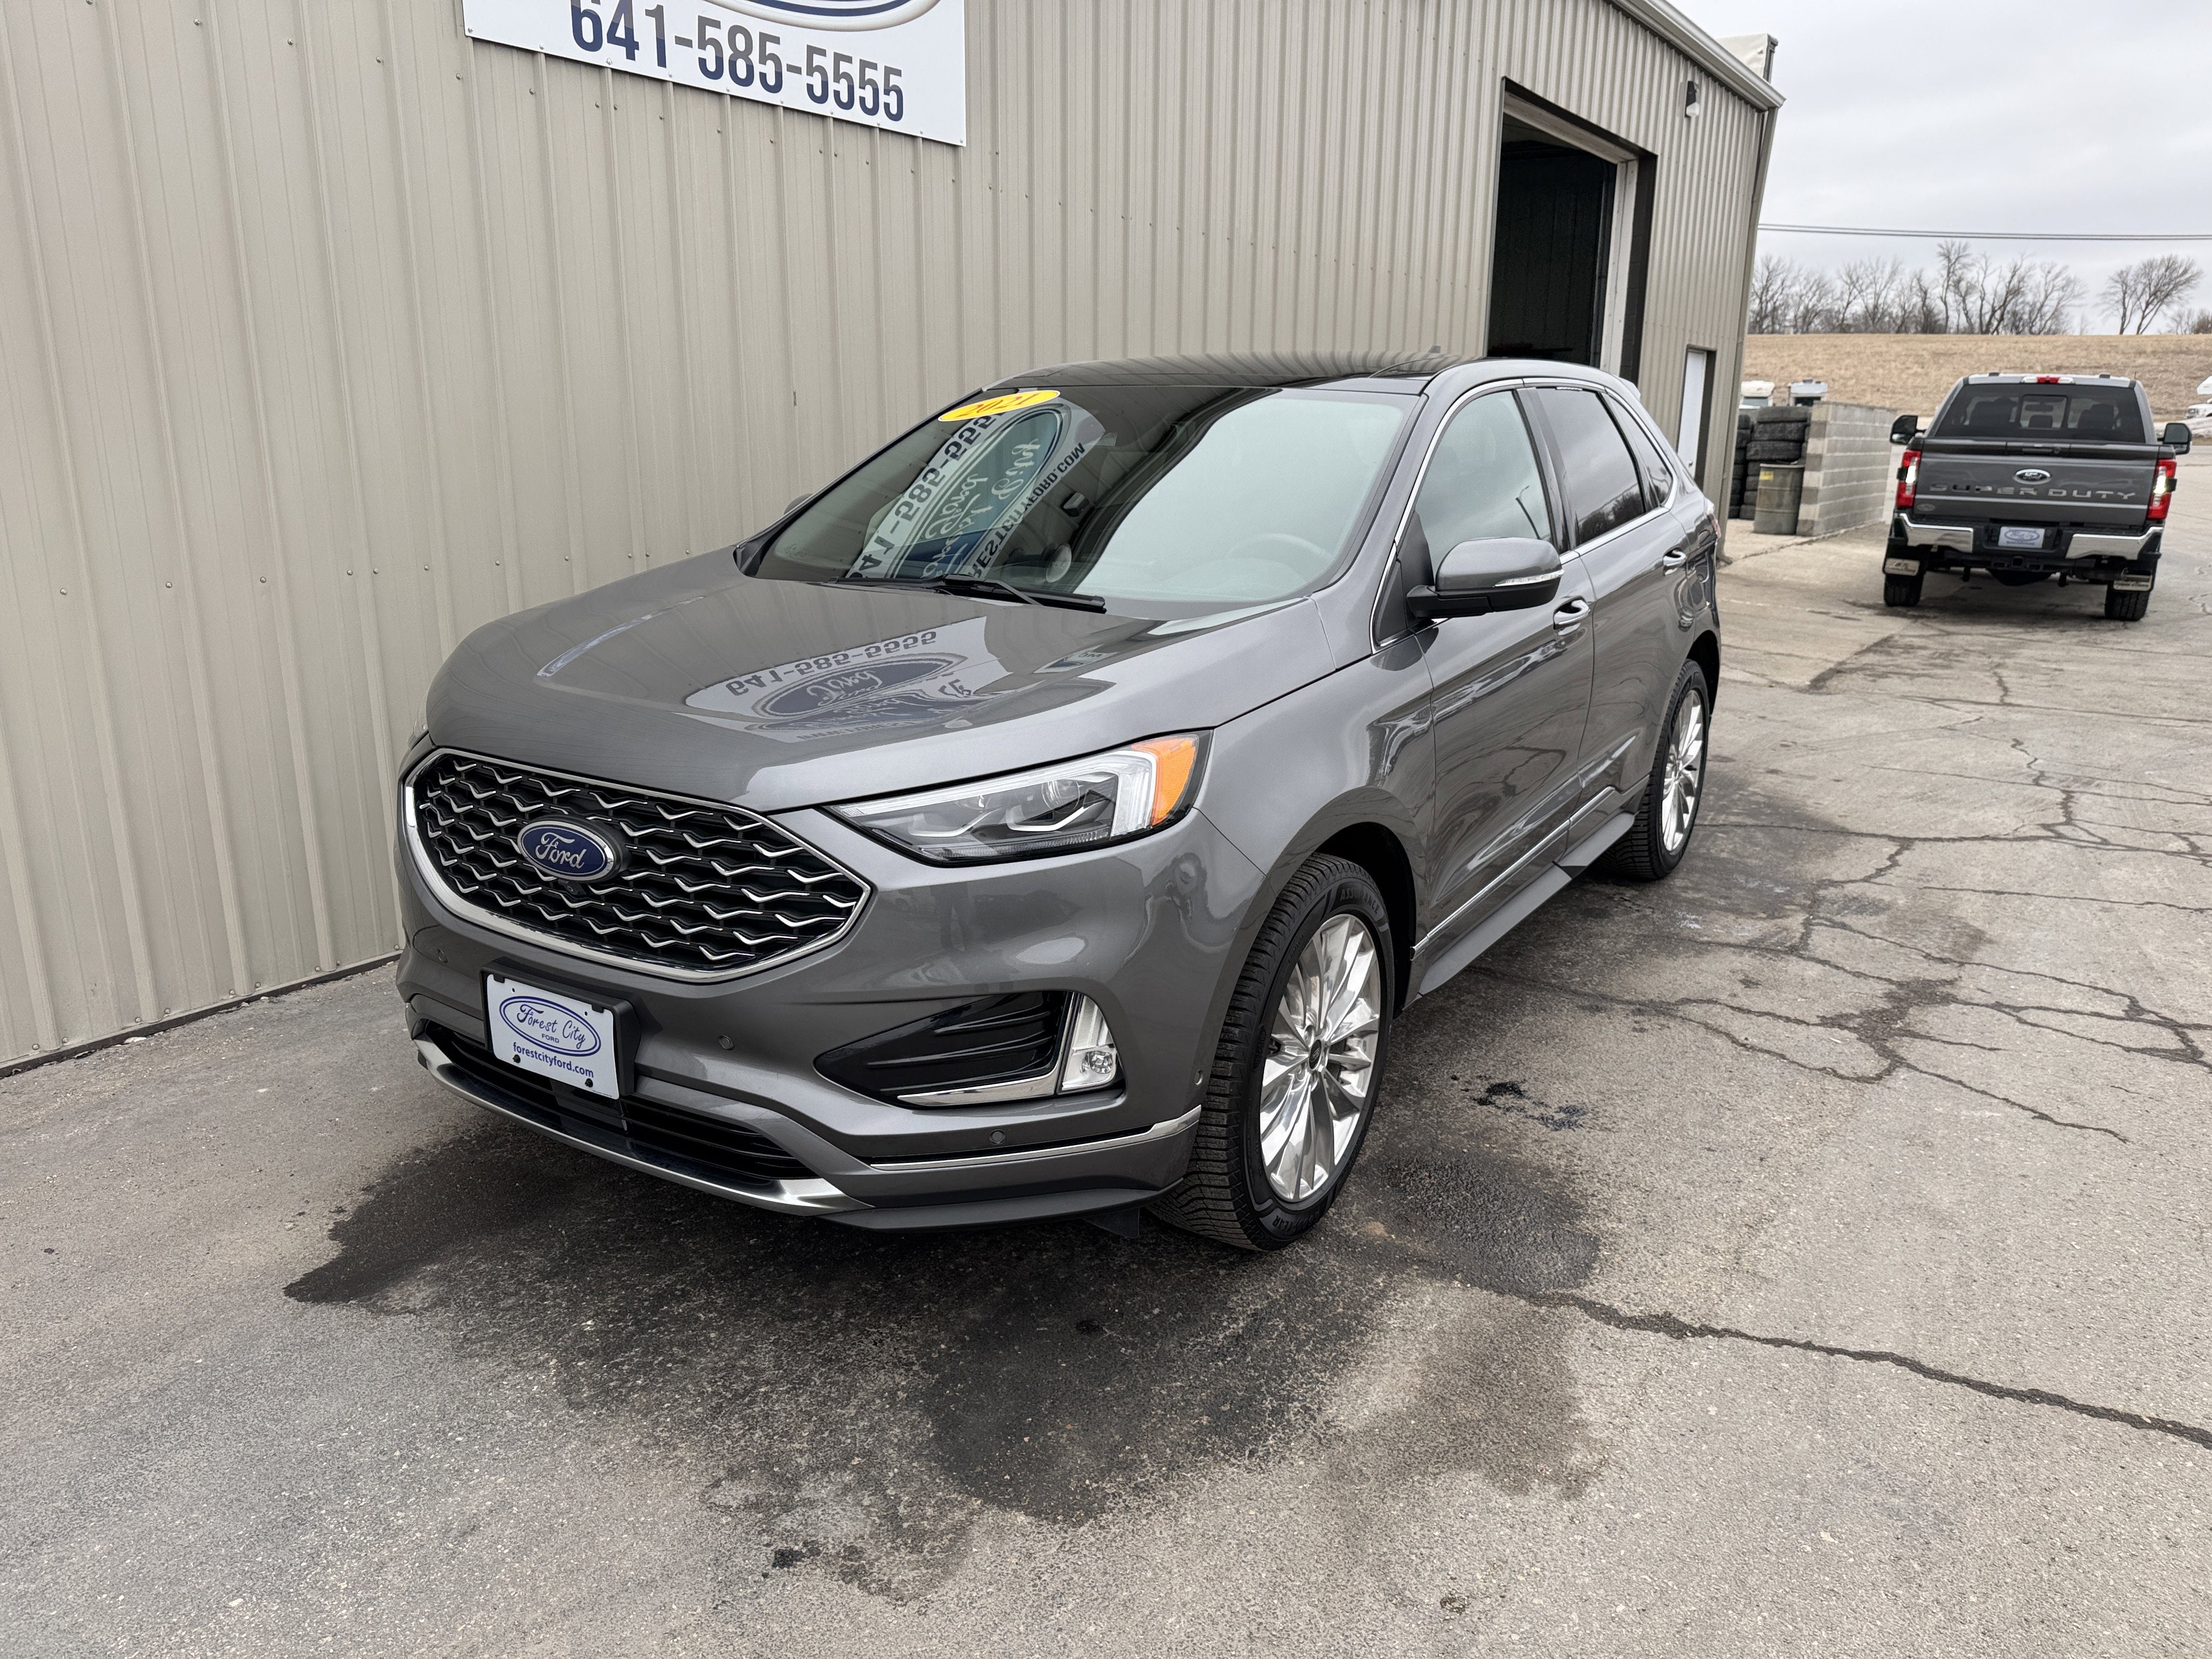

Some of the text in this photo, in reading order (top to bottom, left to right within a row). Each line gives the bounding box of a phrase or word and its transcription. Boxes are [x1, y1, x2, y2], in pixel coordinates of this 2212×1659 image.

[570, 0, 904, 122] 641-585-5555
[954, 393, 1041, 418] 2021
[1929, 483, 2136, 500] SUPER DUTY
[535, 832, 586, 870] Ford
[516, 1003, 585, 1049] Forest City
[541, 1032, 560, 1044] FORD
[513, 1042, 594, 1079] forestcityford.com
